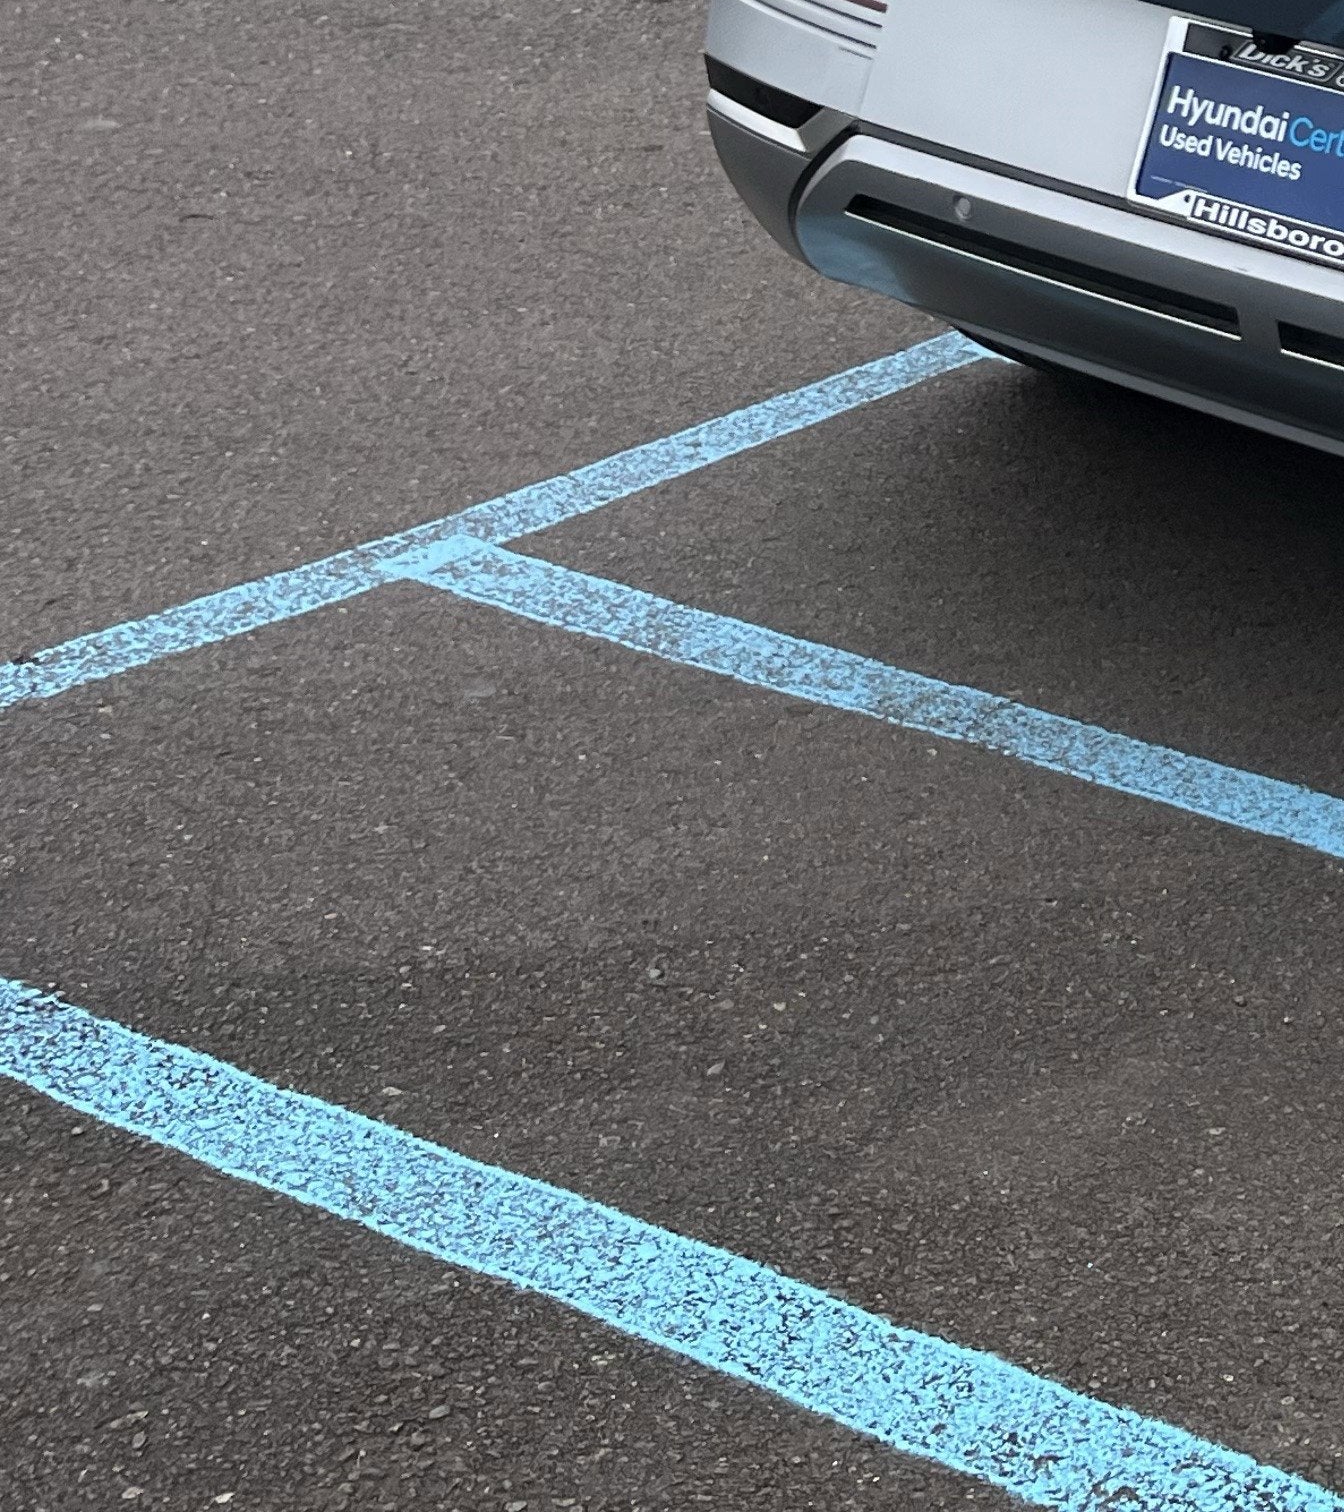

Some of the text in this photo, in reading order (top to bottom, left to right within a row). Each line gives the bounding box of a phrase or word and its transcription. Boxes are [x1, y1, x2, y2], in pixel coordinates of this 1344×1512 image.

[1167, 85, 1290, 142] Hyundai
[1159, 124, 1302, 181] Used Vehicles
